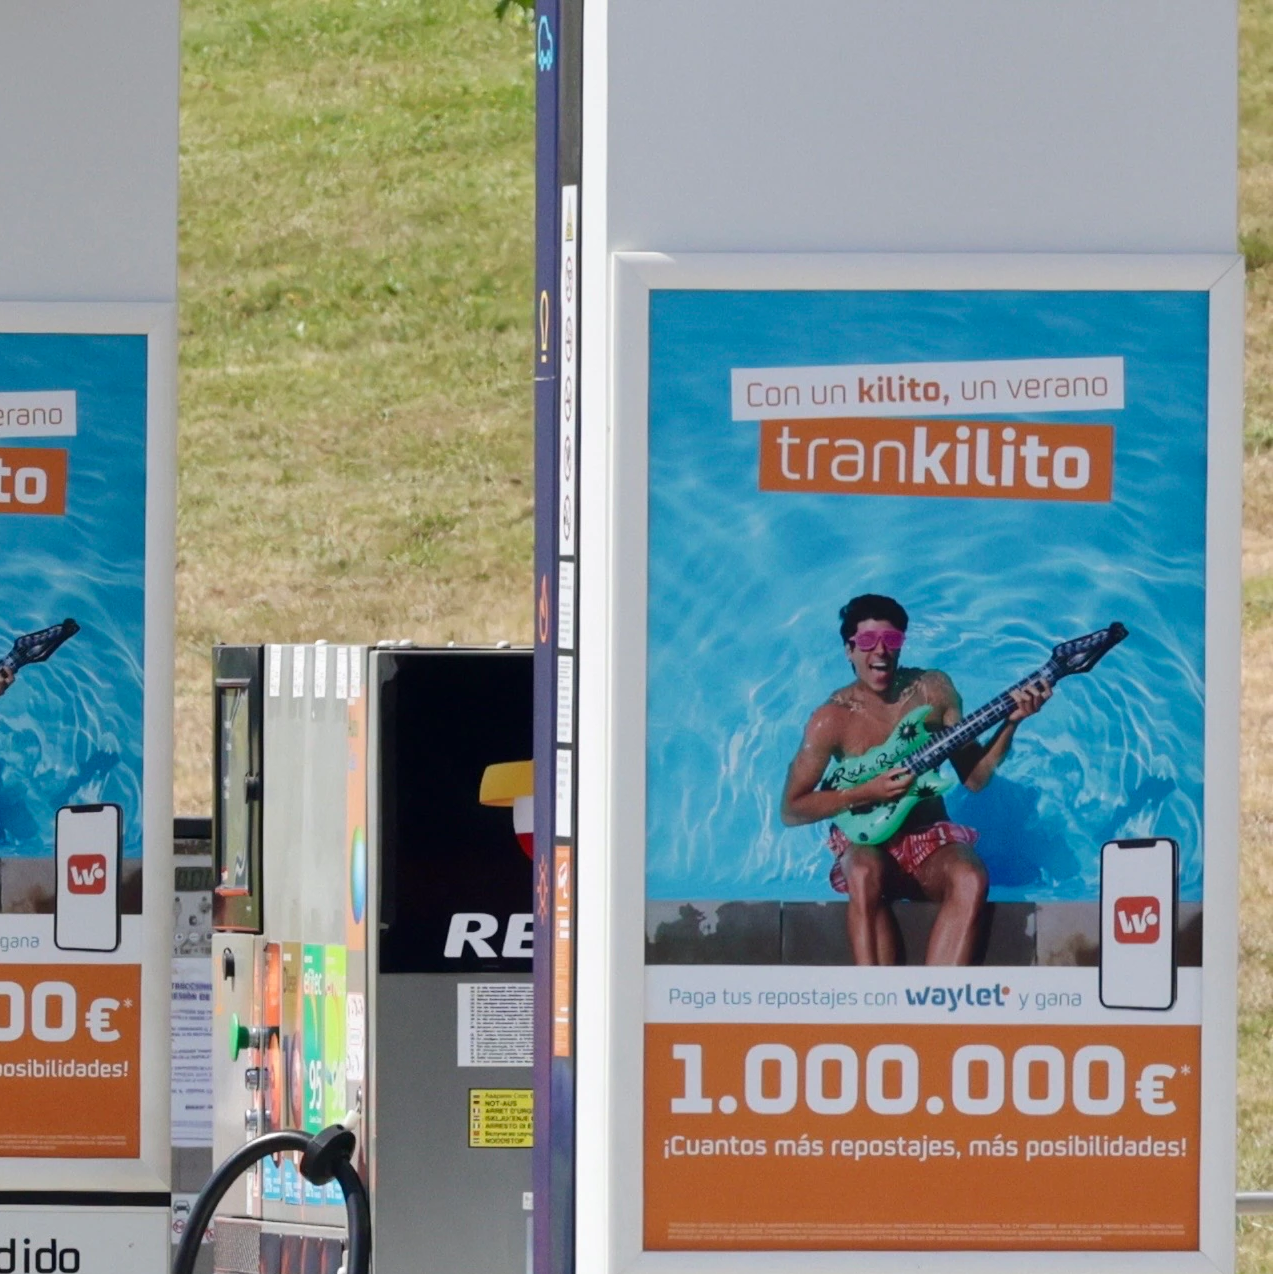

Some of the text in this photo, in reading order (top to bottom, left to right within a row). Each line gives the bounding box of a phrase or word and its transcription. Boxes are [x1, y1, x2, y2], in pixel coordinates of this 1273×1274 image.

[746, 375, 1108, 409] Con un kilito, un verano
[777, 425, 1091, 490] trankilito
[0, 934, 41, 951] gana
[668, 984, 1082, 1012] Paga tus repostajes con waylet y gana
[308, 1059, 323, 1110] 95
[663, 1134, 1188, 1161] ¡Cuantos más repostajes, más posibilidades!
